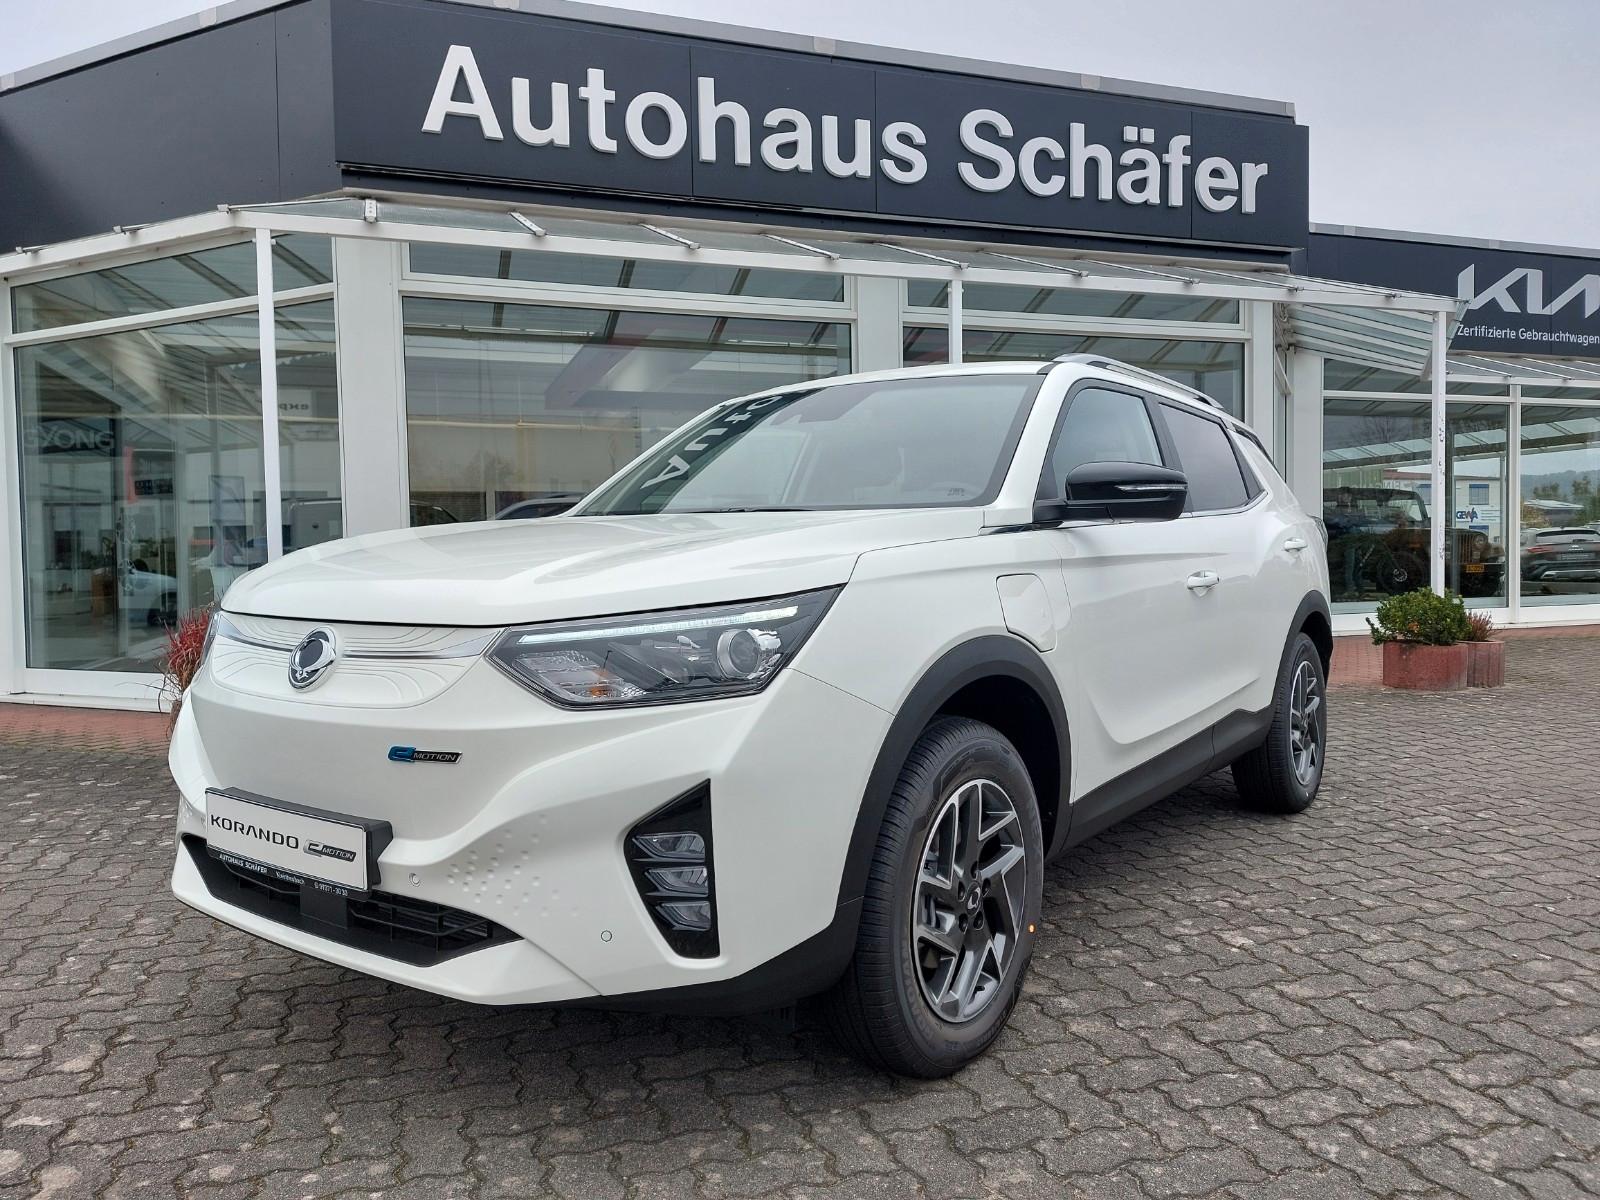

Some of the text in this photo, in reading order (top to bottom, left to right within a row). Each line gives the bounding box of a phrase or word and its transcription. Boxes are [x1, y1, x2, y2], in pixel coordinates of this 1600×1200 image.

[421, 44, 1269, 214] Autohaus Schäfer
[1457, 324, 1600, 347] Zertifizierte Gebrauchtwagen
[210, 814, 299, 850] KORANDO
